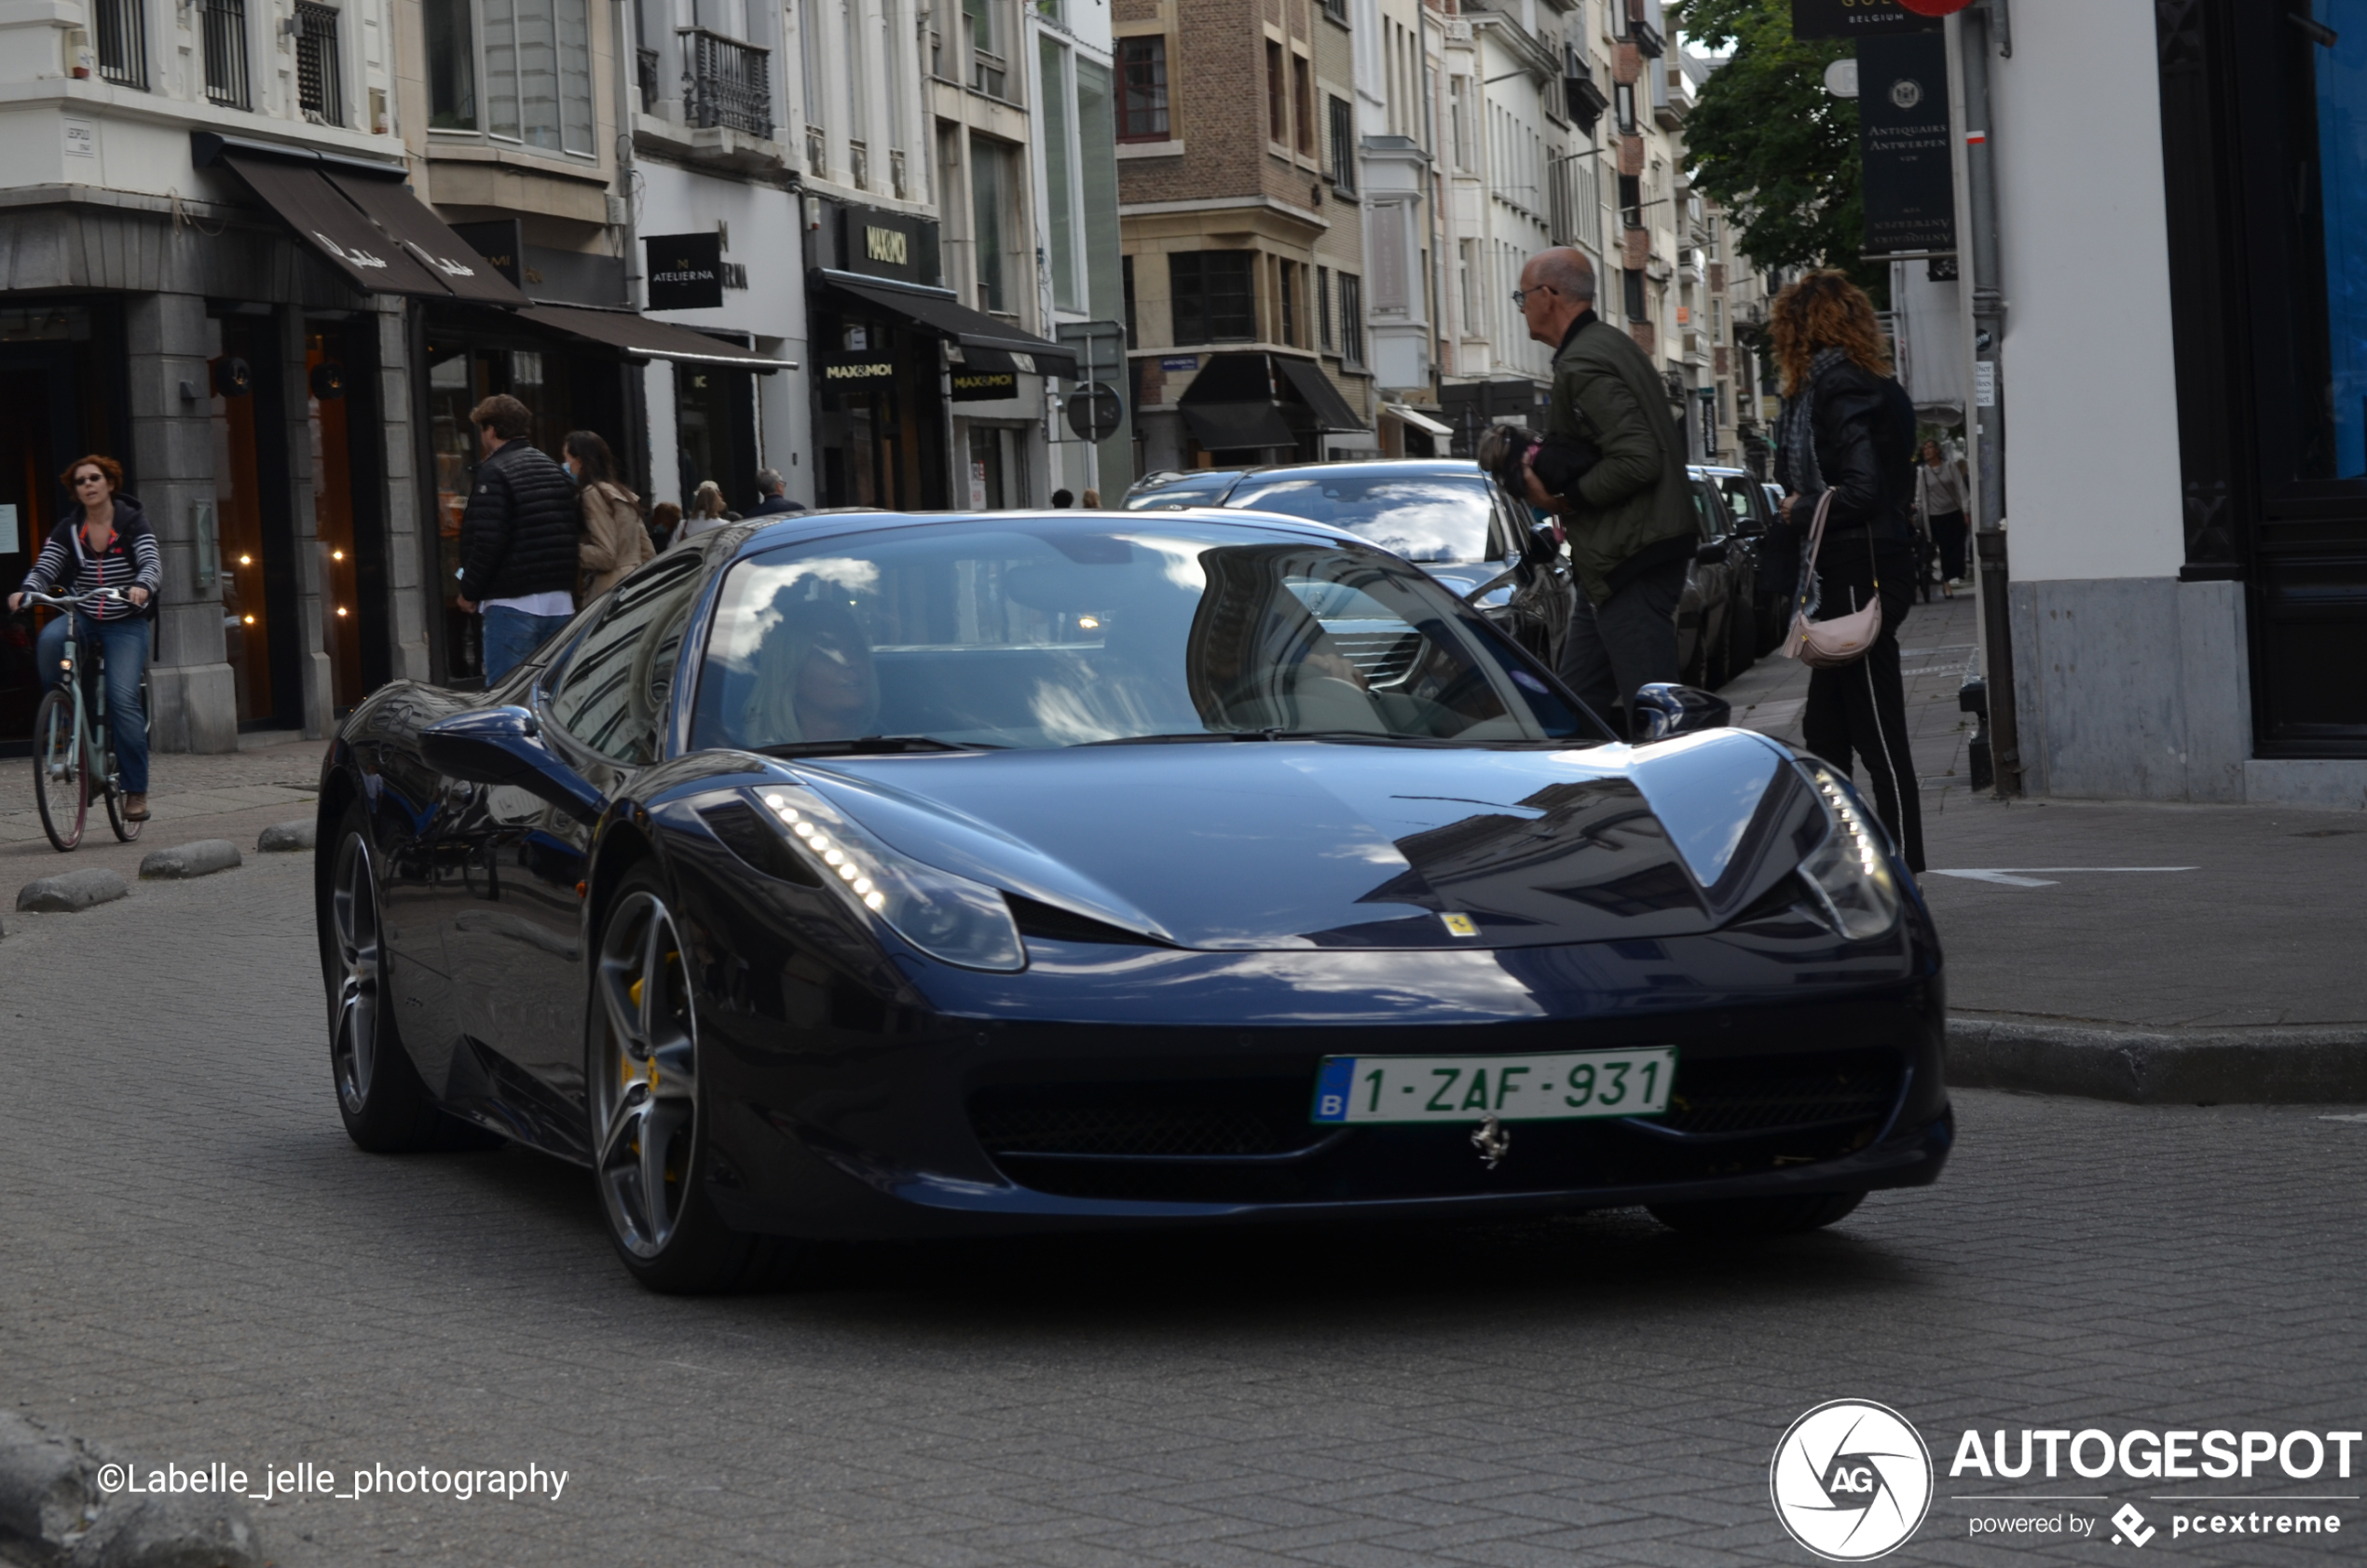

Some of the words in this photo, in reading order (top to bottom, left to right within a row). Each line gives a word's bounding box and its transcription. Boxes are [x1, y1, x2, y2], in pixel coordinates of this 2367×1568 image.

[1848, 13, 1905, 23] BELGIUM
[1868, 124, 1948, 137] ANTIQUAIRS
[1868, 139, 1948, 151] ANTWERPEN
[866, 225, 908, 266] MAX&MOI
[826, 363, 892, 379] MAX&MOI
[953, 374, 1013, 389] MAX&MOI
[1363, 1060, 1661, 1112] 1-ZAF-931
[1320, 1094, 1343, 1116] B
